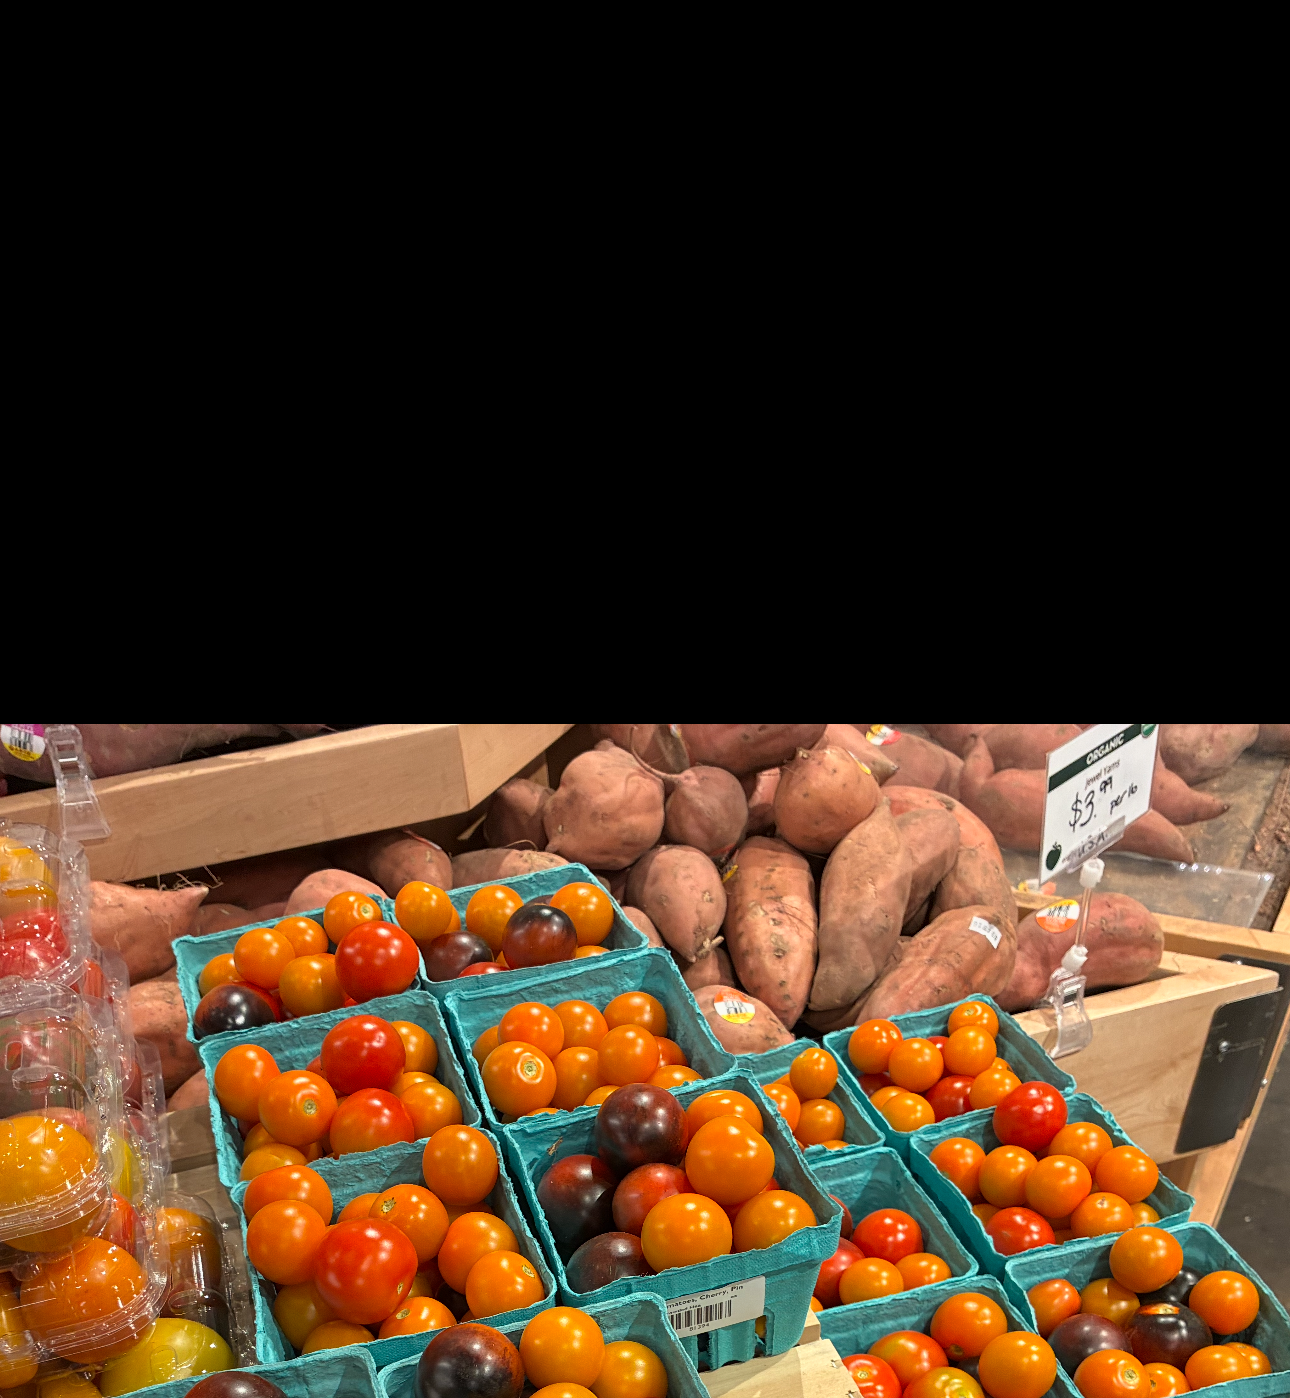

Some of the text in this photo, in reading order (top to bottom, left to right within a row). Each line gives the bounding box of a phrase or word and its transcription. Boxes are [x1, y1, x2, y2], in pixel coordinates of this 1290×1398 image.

[1086, 732, 1125, 765] ORGANIC
[1084, 769, 1103, 791] Jewel
[1109, 789, 1128, 815] per
